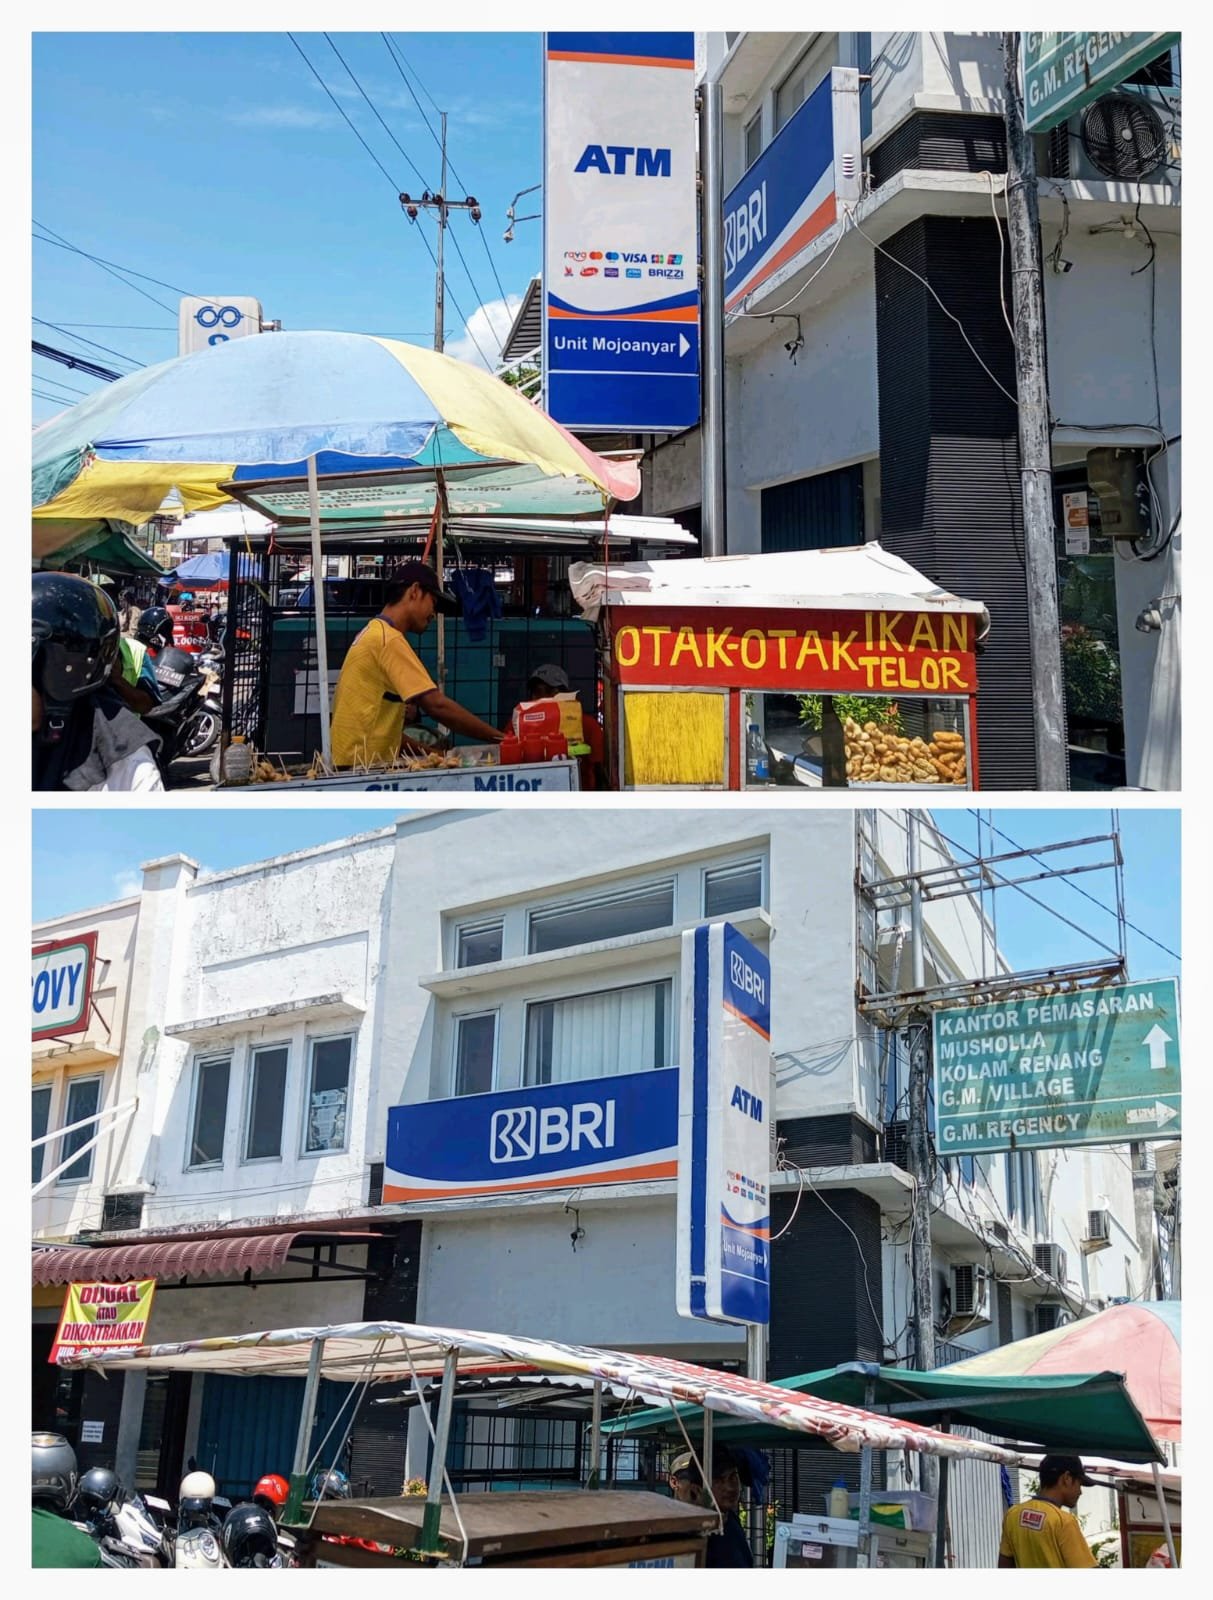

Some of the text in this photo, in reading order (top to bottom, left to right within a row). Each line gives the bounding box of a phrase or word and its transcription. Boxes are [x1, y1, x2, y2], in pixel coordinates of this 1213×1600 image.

[1029, 32, 1134, 107] G.M. REGEN
[574, 144, 671, 177] ATM
[736, 179, 767, 263] BRI
[621, 252, 648, 264] VISA
[648, 268, 684, 278] BRIZZI
[554, 336, 677, 356] Unit Mojoanyar
[615, 625, 859, 672] OTAK-OTAK
[865, 611, 968, 653] IKAN
[858, 656, 968, 690] TELOR
[474, 774, 543, 791] Milor
[32, 962, 83, 1014] OVY
[745, 963, 765, 1006] BRI
[939, 992, 1154, 1036] KANTOR PEMASARAN
[940, 1031, 1046, 1060] MUSHOLLA
[941, 1049, 1103, 1083] KOLAM RENANG
[731, 1084, 763, 1123] ATM
[942, 1077, 1075, 1107] G.M. VILLAGE
[539, 1099, 616, 1155] BRI
[943, 1113, 1081, 1143] G.M. REGENCY
[723, 1239, 765, 1266] Unit Mojoanyar
[80, 1285, 141, 1304] DIJUAL
[96, 1307, 117, 1320] ATAU
[61, 1322, 144, 1341] DIKONTRAKKAN
